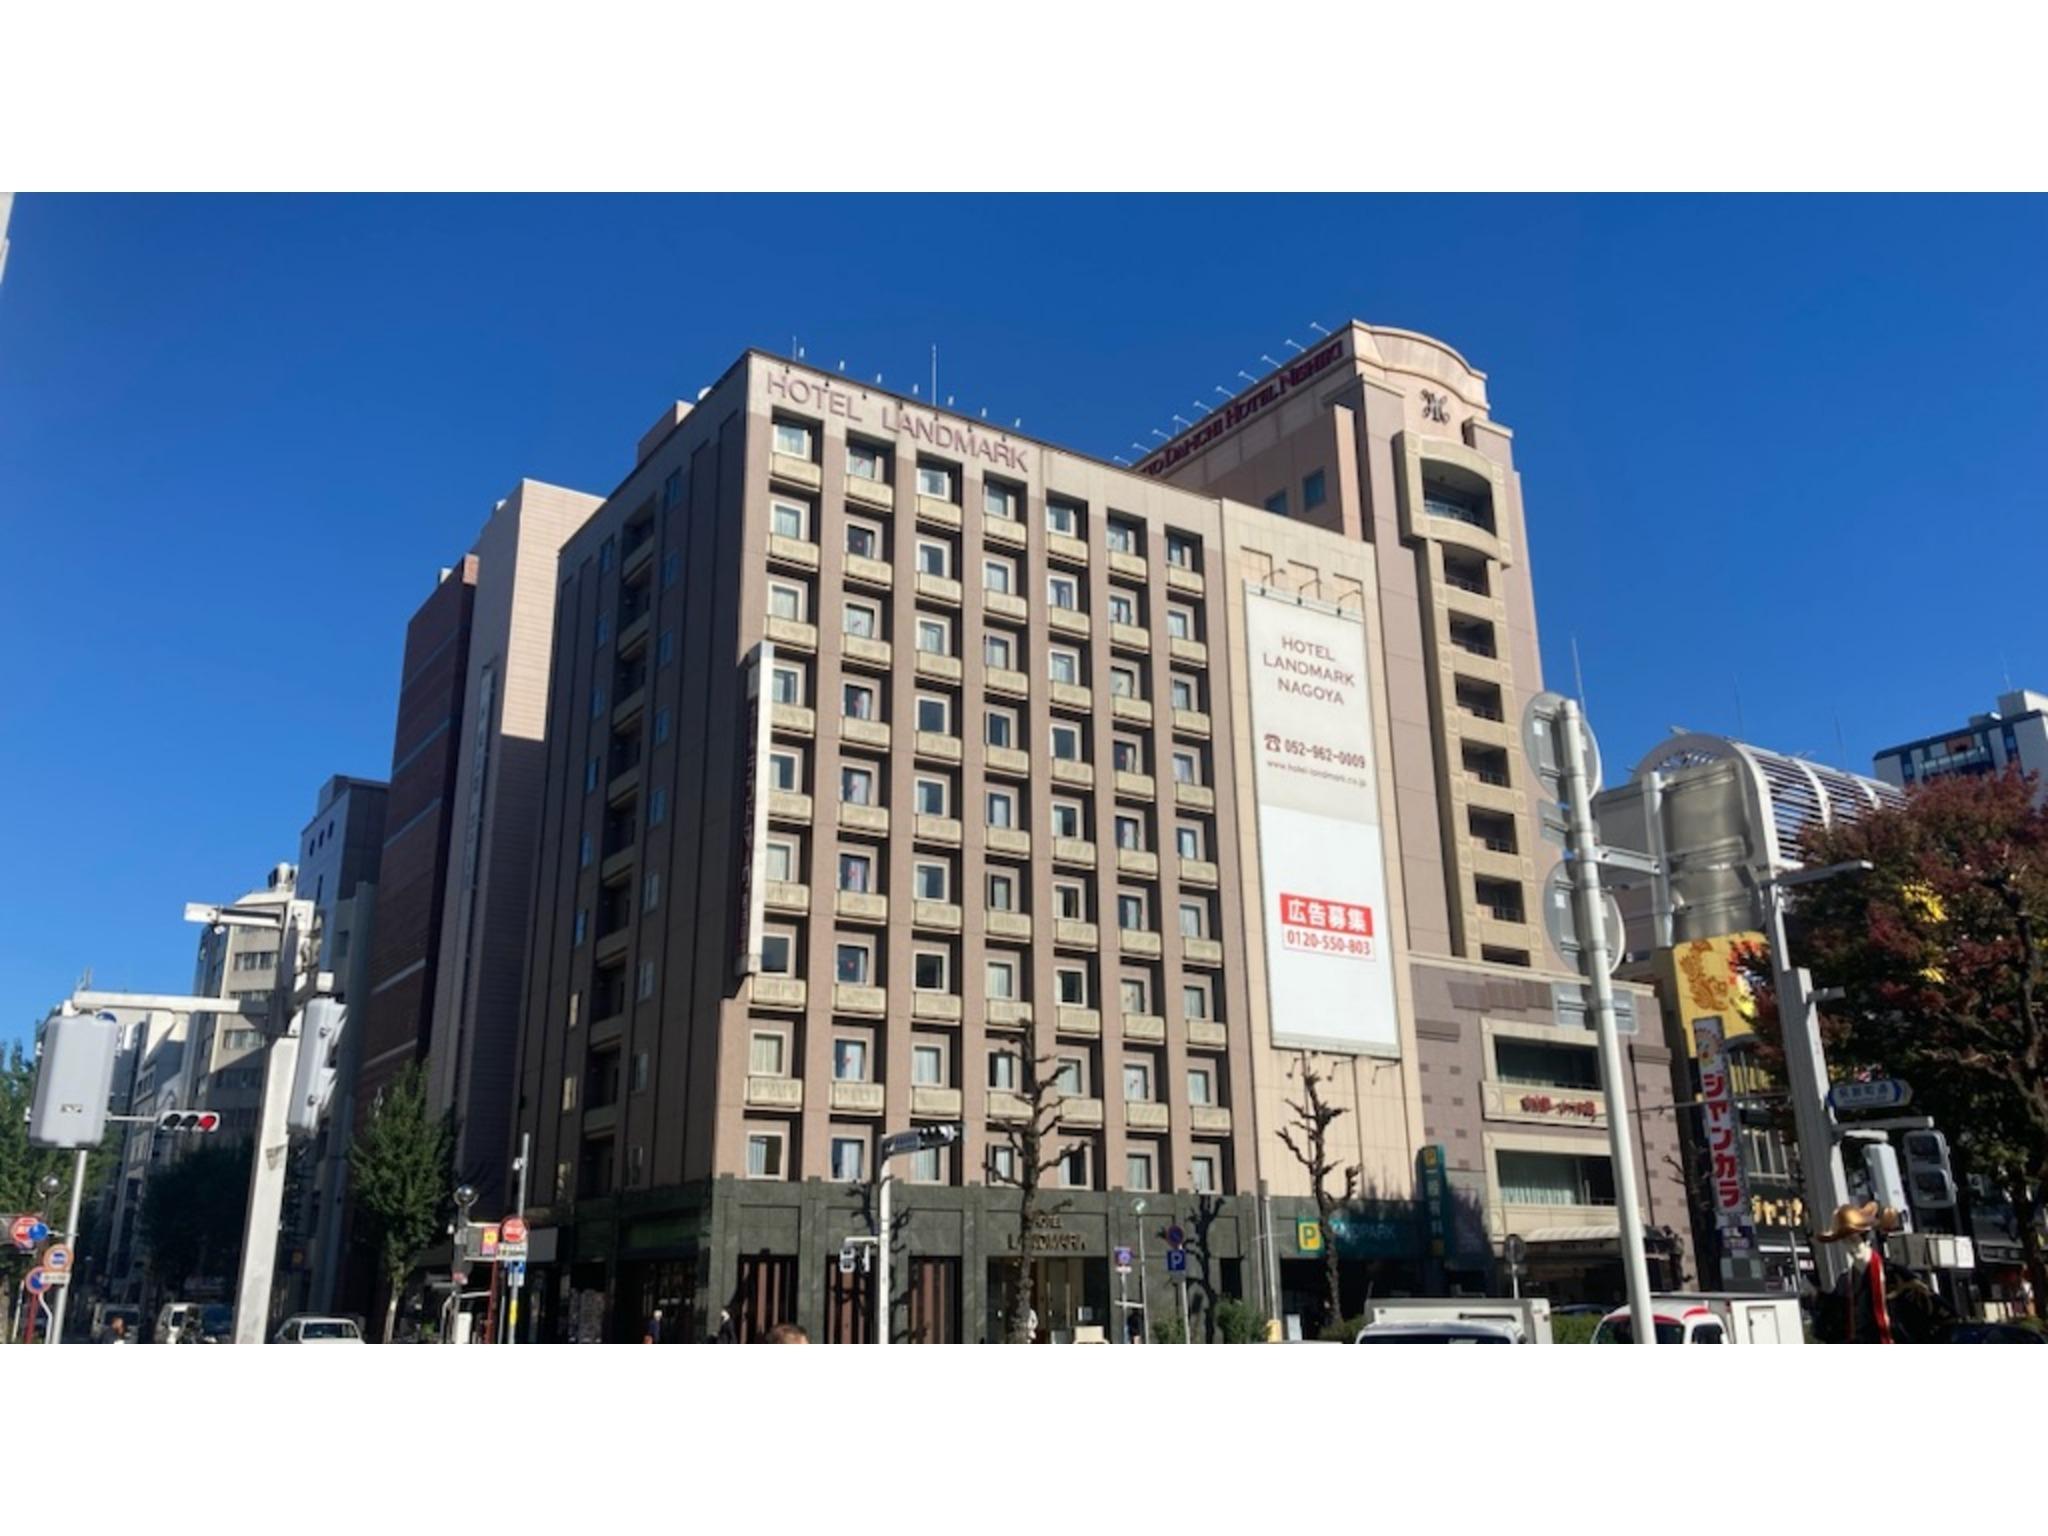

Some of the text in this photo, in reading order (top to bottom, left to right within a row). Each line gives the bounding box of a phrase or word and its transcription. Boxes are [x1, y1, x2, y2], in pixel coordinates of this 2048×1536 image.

[767, 371, 1028, 473] HOTEL LANDMARK
[1225, 384, 1280, 429] HOTEL
[1282, 636, 1335, 662] HOTEL
[1263, 652, 1355, 687] LANDMARK
[1278, 677, 1344, 705] NAGOYA
[1288, 898, 1367, 933] 広告募集
[1703, 1072, 1741, 1208] ジャンカラ
